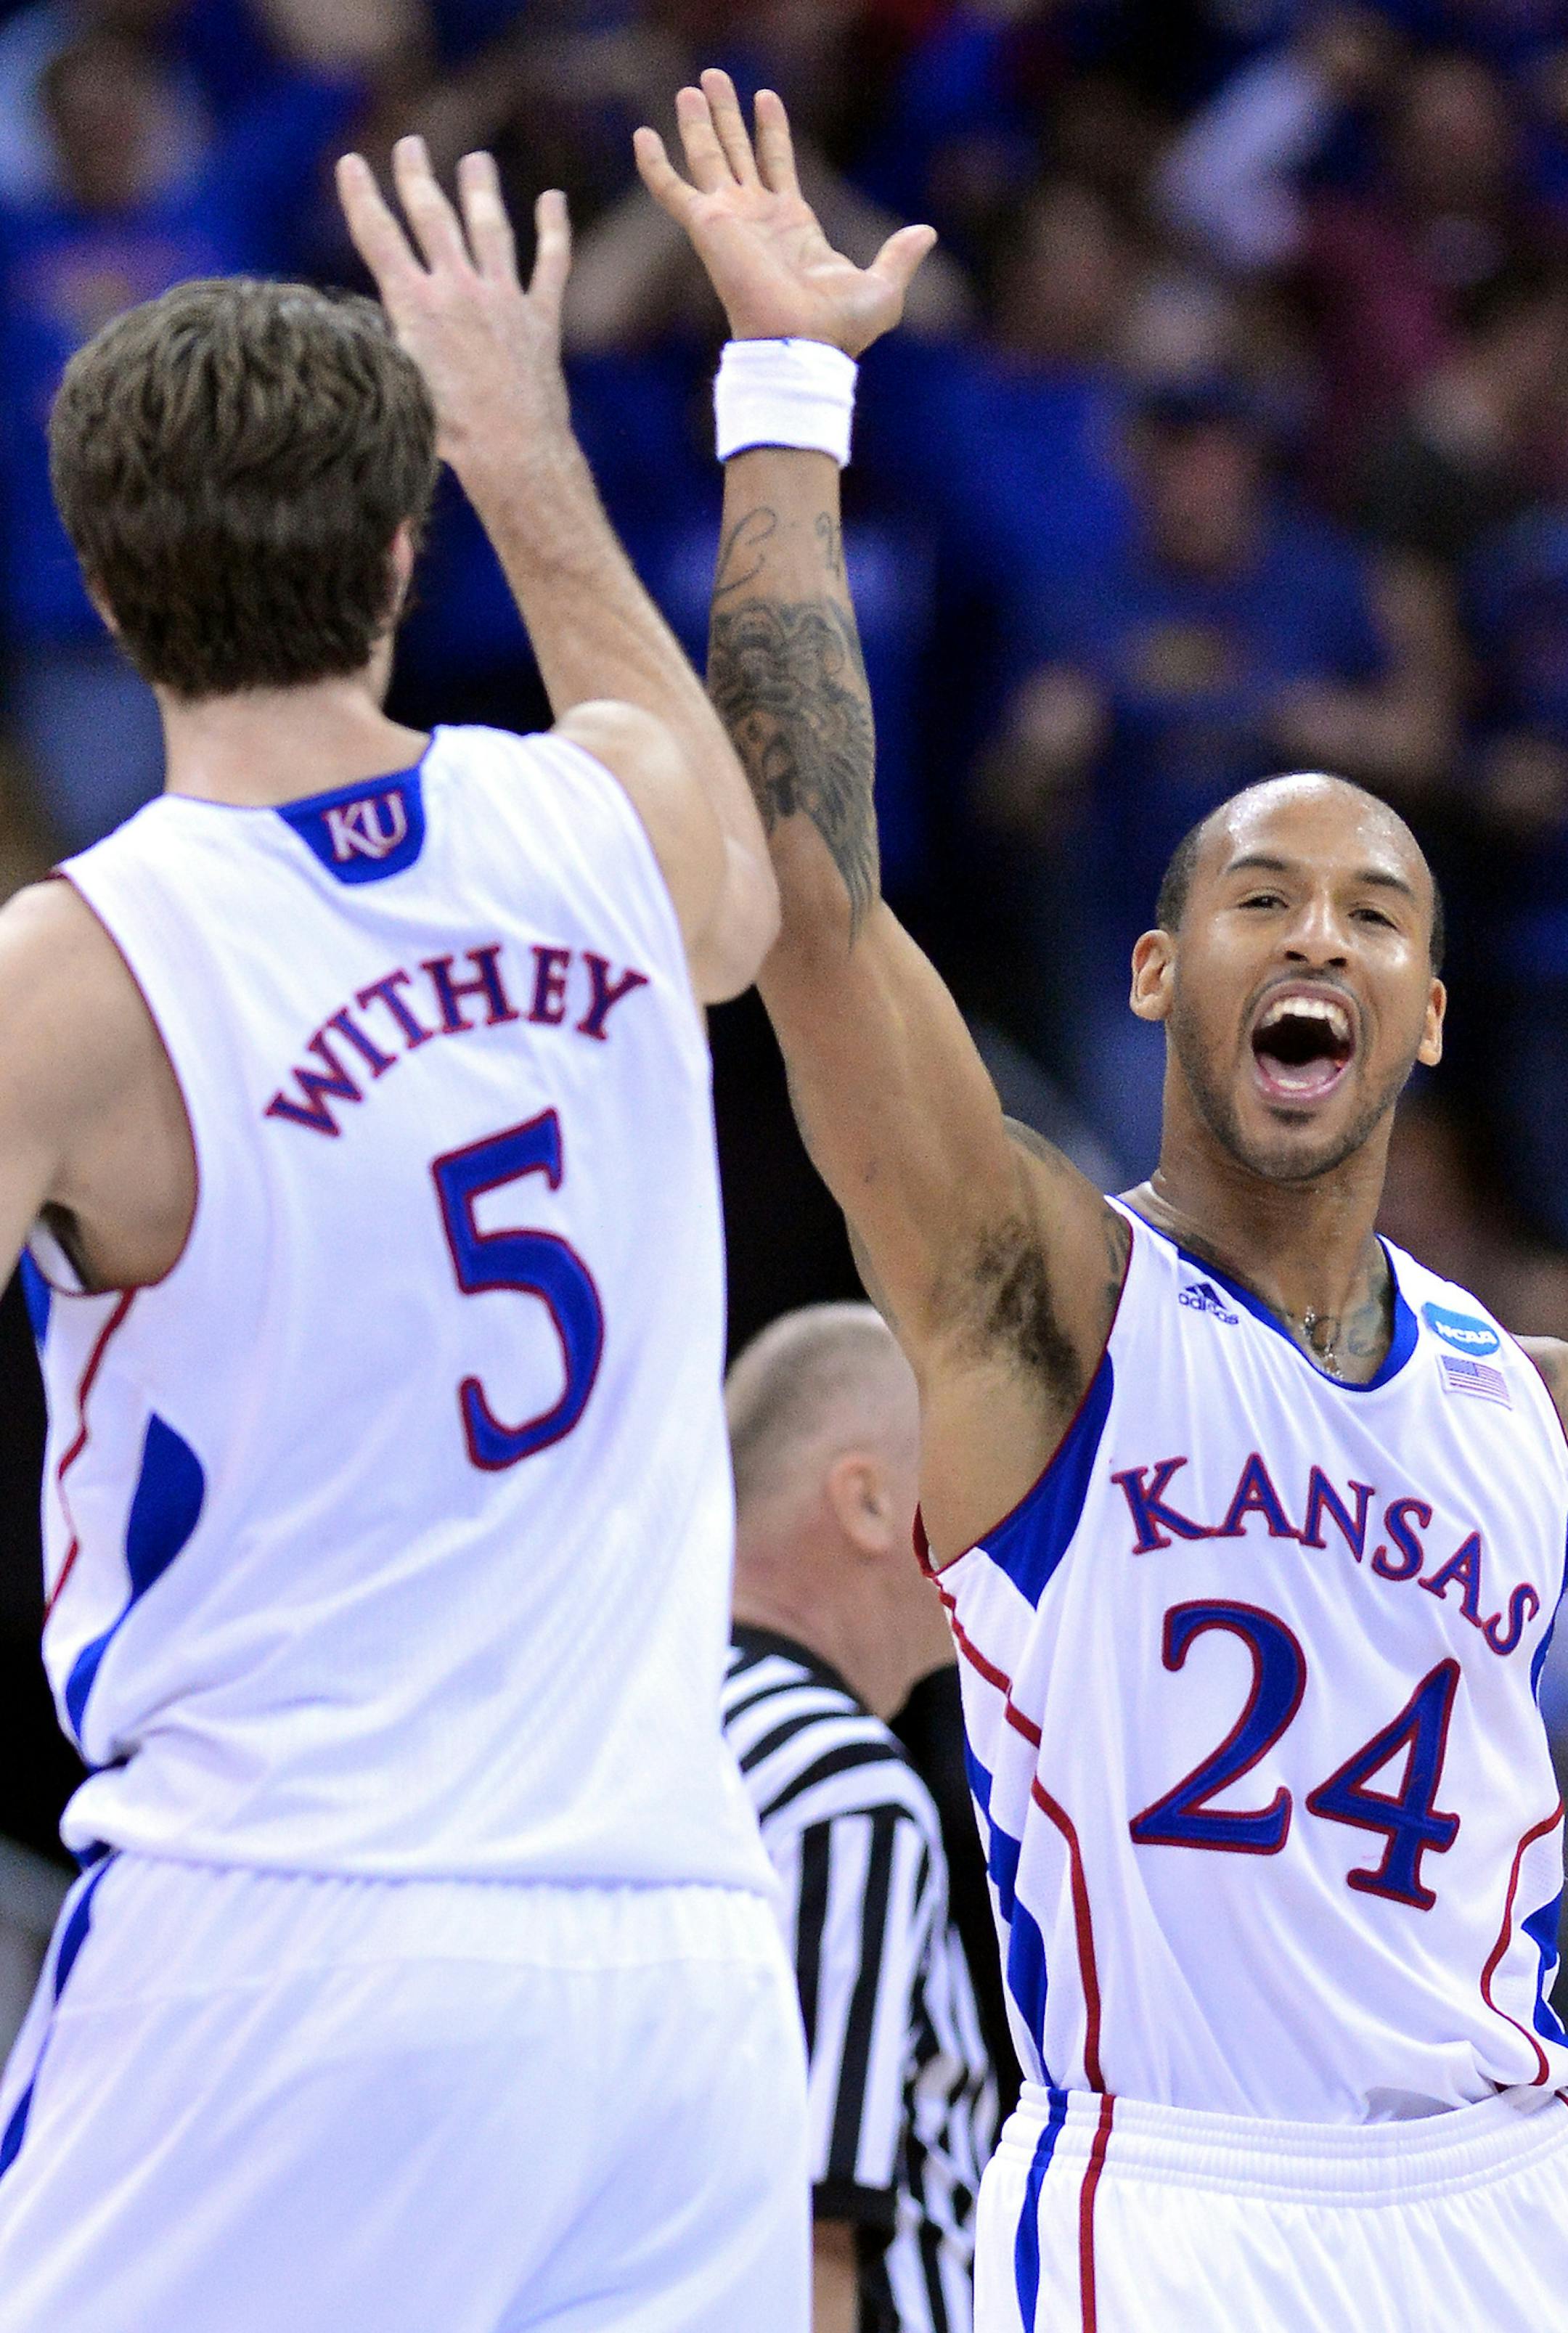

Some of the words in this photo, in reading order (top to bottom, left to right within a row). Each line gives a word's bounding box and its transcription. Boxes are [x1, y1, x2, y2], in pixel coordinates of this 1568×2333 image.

[321, 789, 409, 862] KU
[264, 942, 649, 1138] WITHEY
[430, 1106, 605, 1471] 5
[1434, 1320, 1498, 1344] NCAA
[1111, 1452, 1540, 1656] KANSAS
[1130, 1598, 1461, 1911] 24
